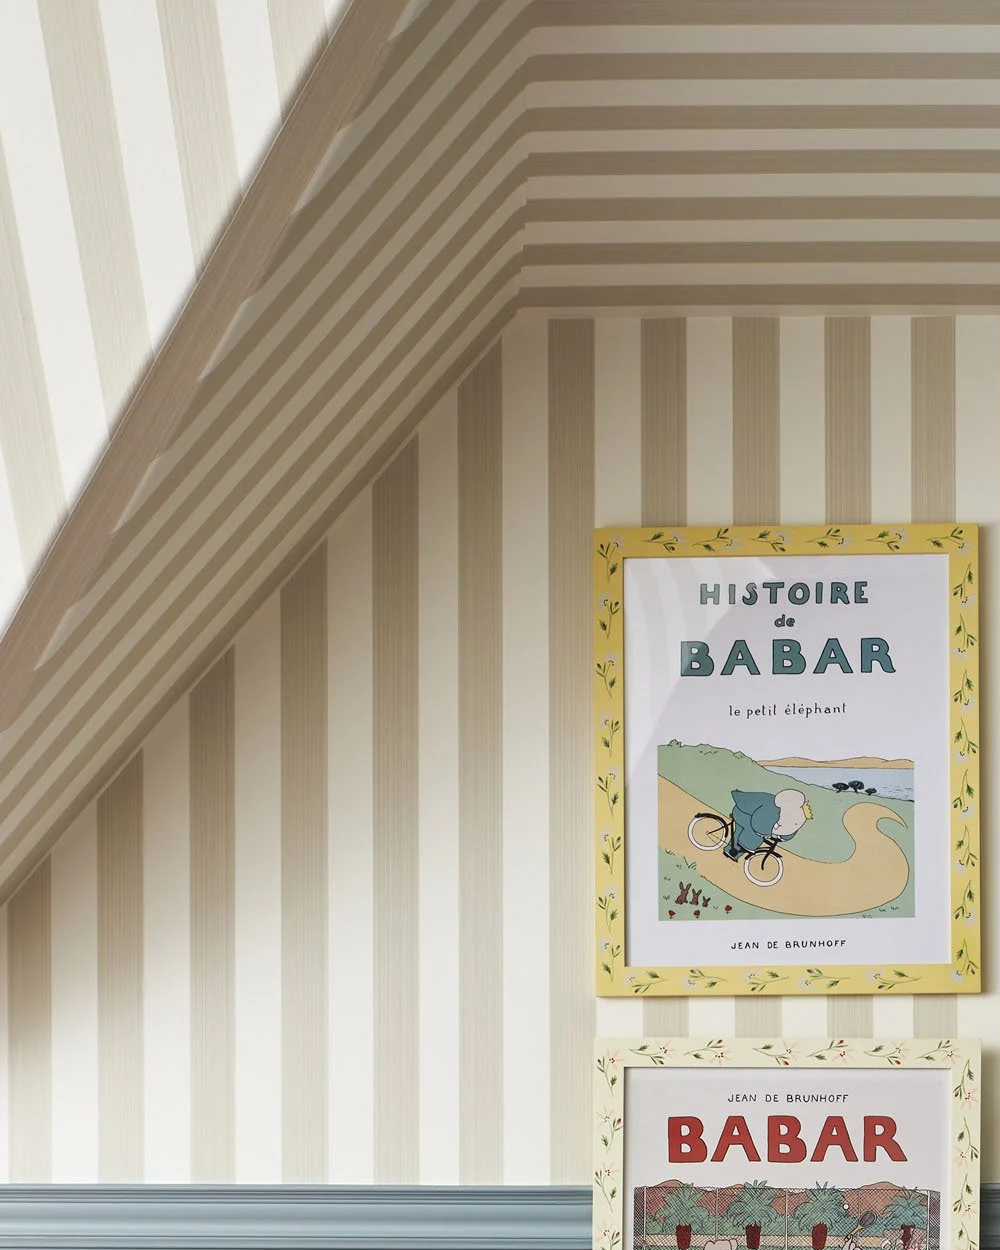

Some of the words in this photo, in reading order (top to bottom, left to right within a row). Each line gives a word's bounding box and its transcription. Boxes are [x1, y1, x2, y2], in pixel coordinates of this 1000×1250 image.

[699, 580, 869, 606] HISTOIRE
[773, 613, 796, 628] de
[680, 636, 897, 678] BABAR
[729, 704, 741, 717] le
[746, 703, 777, 720] petit
[784, 702, 846, 719] éléphant
[730, 941, 760, 950] JEAN
[767, 940, 779, 950] DE
[785, 939, 847, 949] BRUNHOFF
[727, 1093, 757, 1103] JEAN
[764, 1093, 779, 1103] DE
[786, 1093, 849, 1103] BRUNHOFF
[667, 1114, 909, 1164] BABAR
